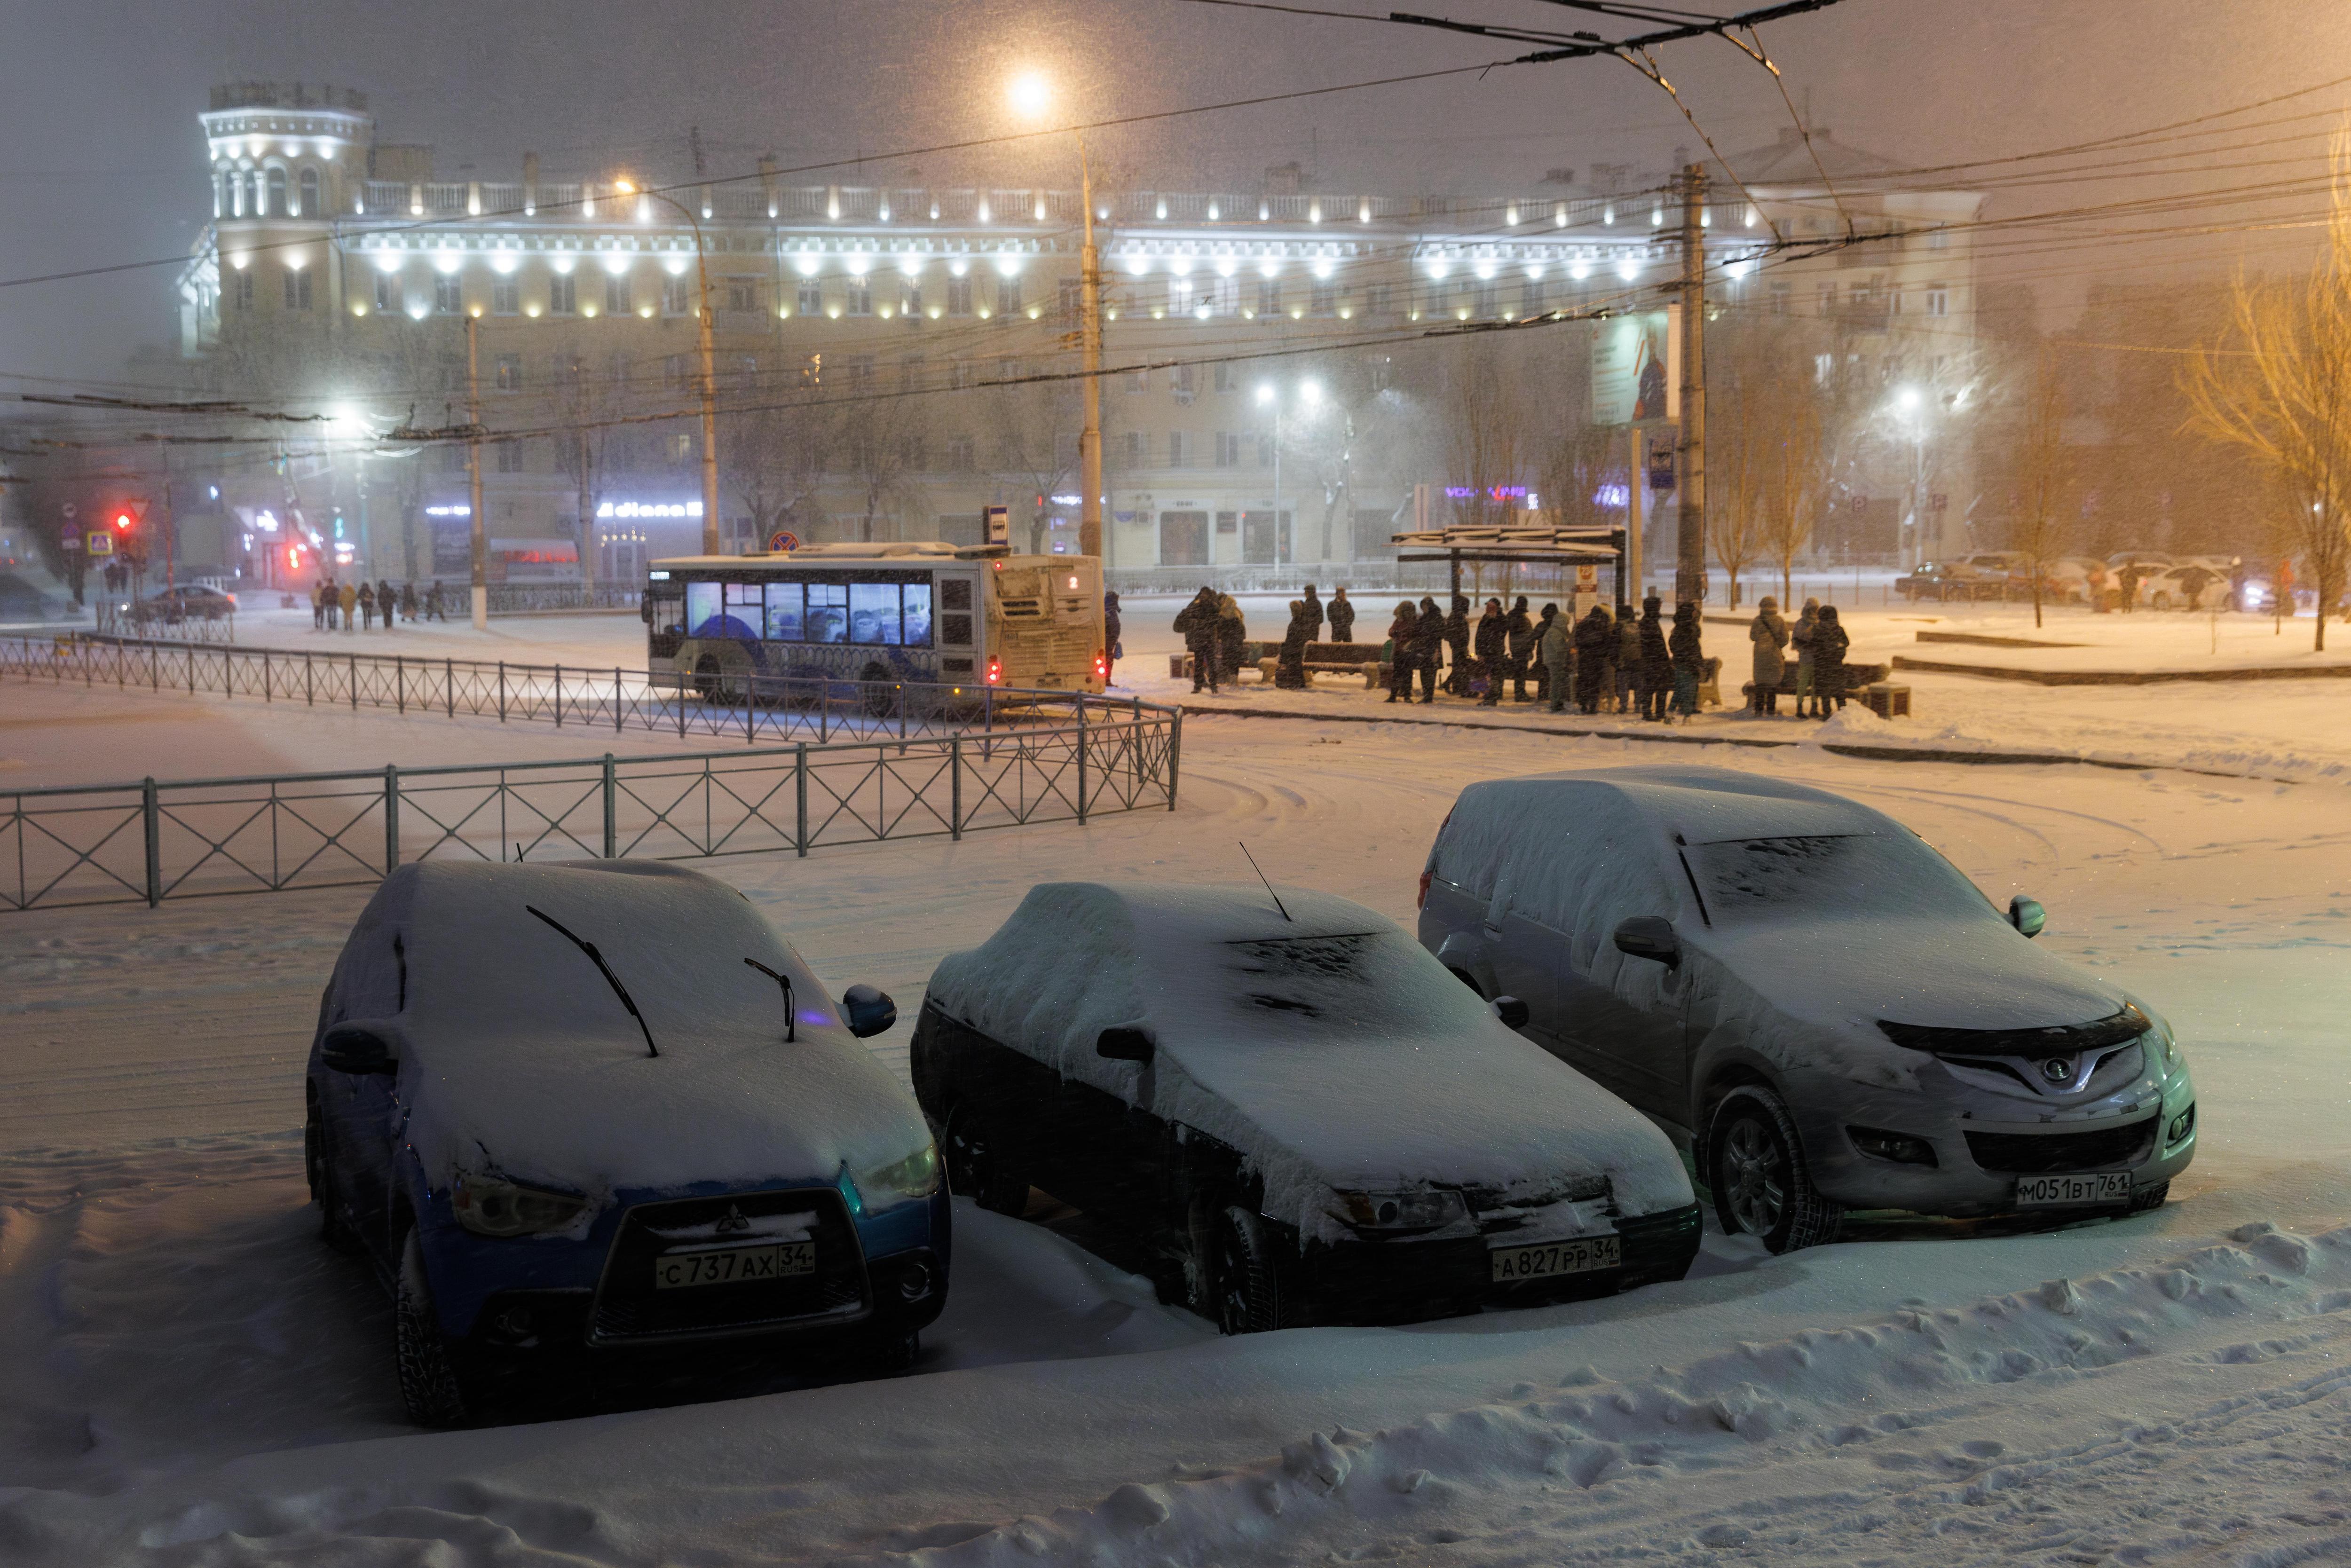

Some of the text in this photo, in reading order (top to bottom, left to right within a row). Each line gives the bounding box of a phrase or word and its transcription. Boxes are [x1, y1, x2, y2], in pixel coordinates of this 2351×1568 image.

[1069, 576, 1079, 589] 2
[2023, 1174, 2126, 1201] М051ВТ 761
[665, 1245, 807, 1284] С737АХ 34
[780, 1265, 799, 1274] RUS
[1502, 1239, 1614, 1277] А827РР 34
